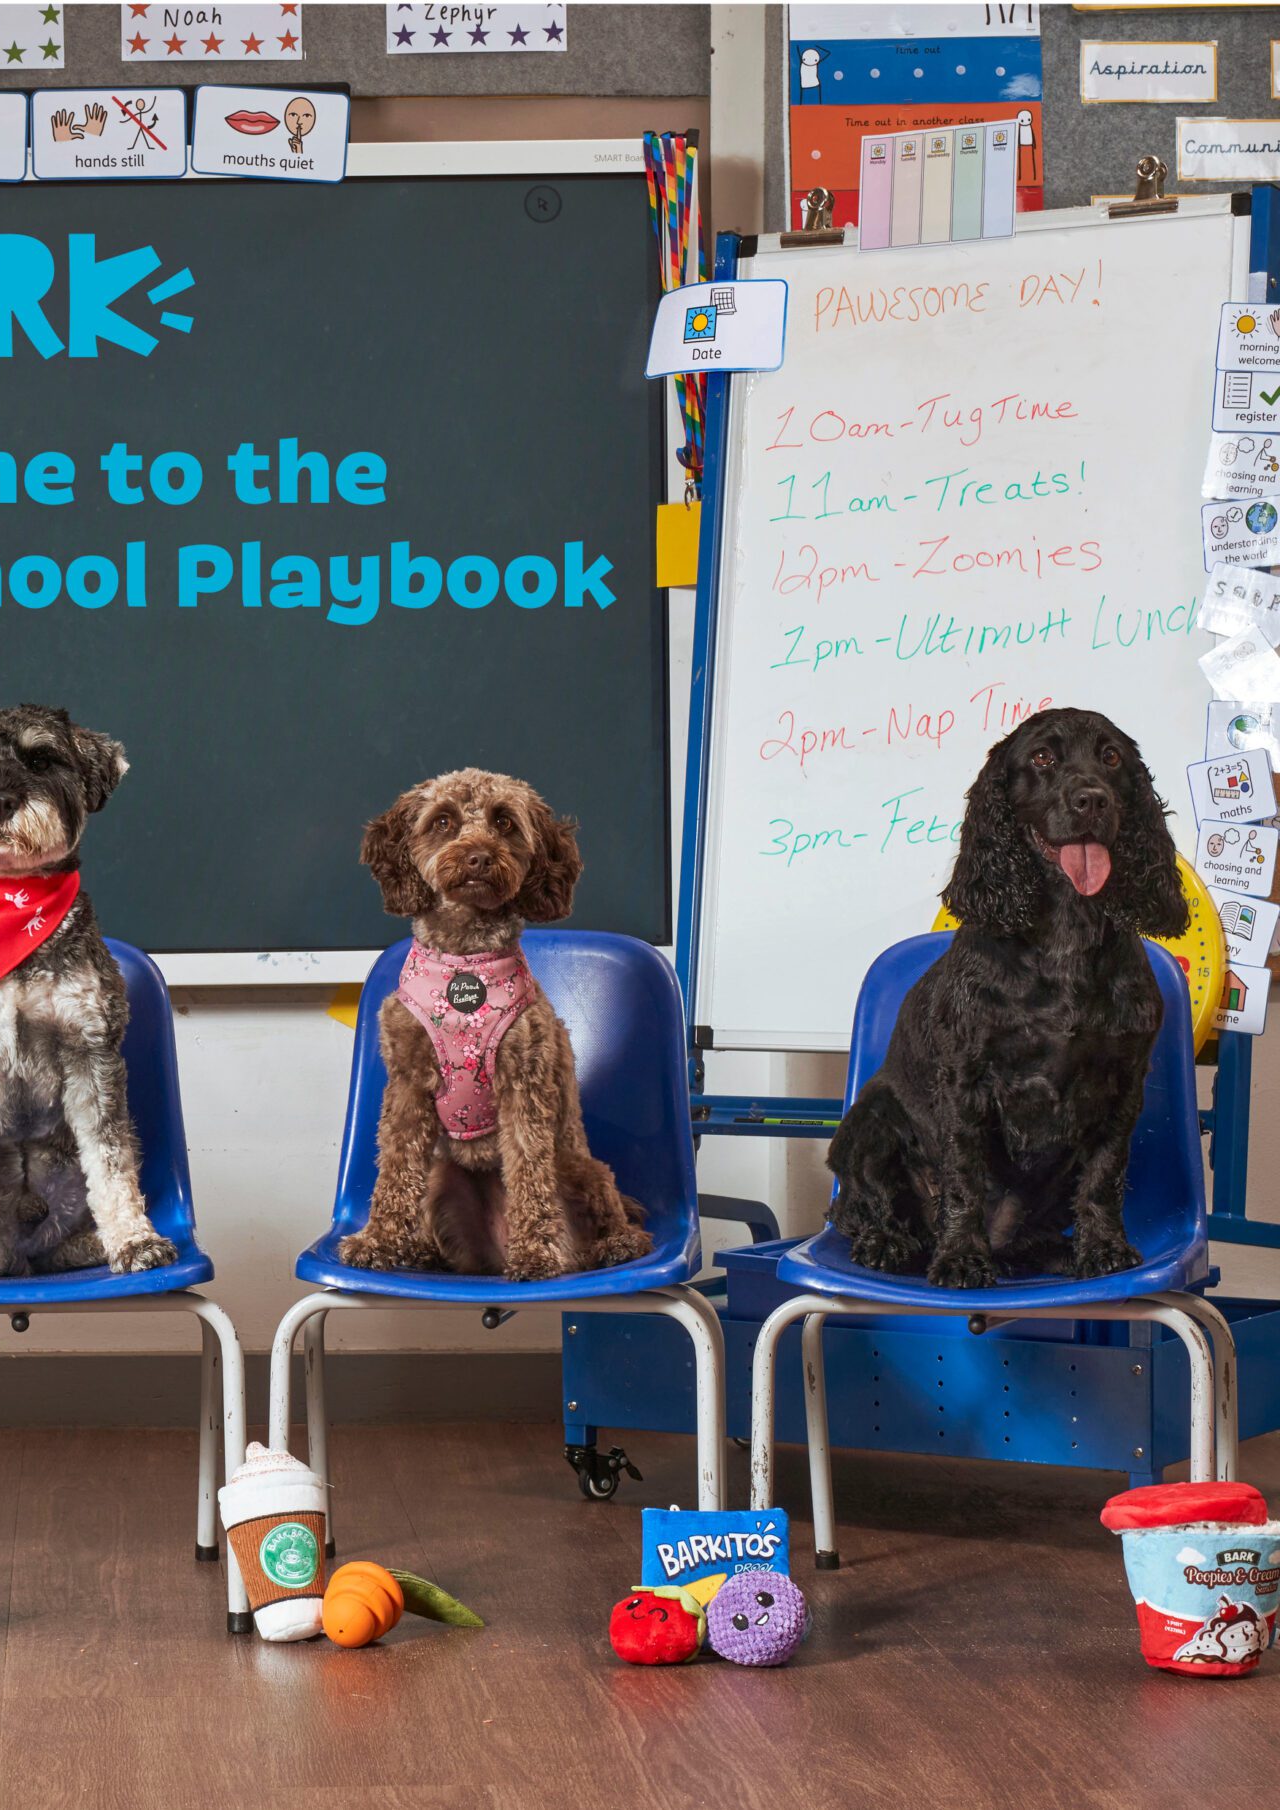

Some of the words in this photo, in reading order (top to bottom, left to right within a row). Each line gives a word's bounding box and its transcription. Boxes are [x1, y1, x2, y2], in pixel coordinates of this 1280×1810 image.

[164, 8, 222, 28] Noah
[424, 4, 497, 27] Zephyr
[895, 45, 920, 54] Time
[924, 46, 941, 54] out
[1090, 60, 1207, 80] Aspiration
[845, 117, 870, 127] Time
[875, 117, 891, 126] out
[896, 116, 907, 126] in
[912, 116, 954, 126] another
[75, 155, 117, 168] hands
[121, 153, 145, 168] still
[223, 152, 275, 169] mouths
[279, 156, 314, 171] quiet
[594, 154, 622, 162] SMART
[814, 282, 990, 332] PAWESOME
[1019, 259, 1102, 307] DAY!
[692, 347, 722, 361] Date
[1239, 343, 1280, 355] morning
[1235, 411, 1278, 424] register
[1216, 469, 1257, 483] choosing
[1259, 474, 1277, 483] and
[1226, 484, 1264, 497] learning
[1211, 535, 1279, 552] understanding
[1225, 554, 1239, 563] the
[1242, 550, 1268, 562] world
[1220, 805, 1253, 820] maths
[1204, 860, 1243, 876] choosing
[1245, 866, 1262, 875] and
[1214, 875, 1250, 892] learning
[1197, 967, 1210, 978] 15
[657, 1532, 780, 1577] BARKITOS
[1224, 1551, 1255, 1562] BARK
[1186, 1567, 1232, 1587] Poopies
